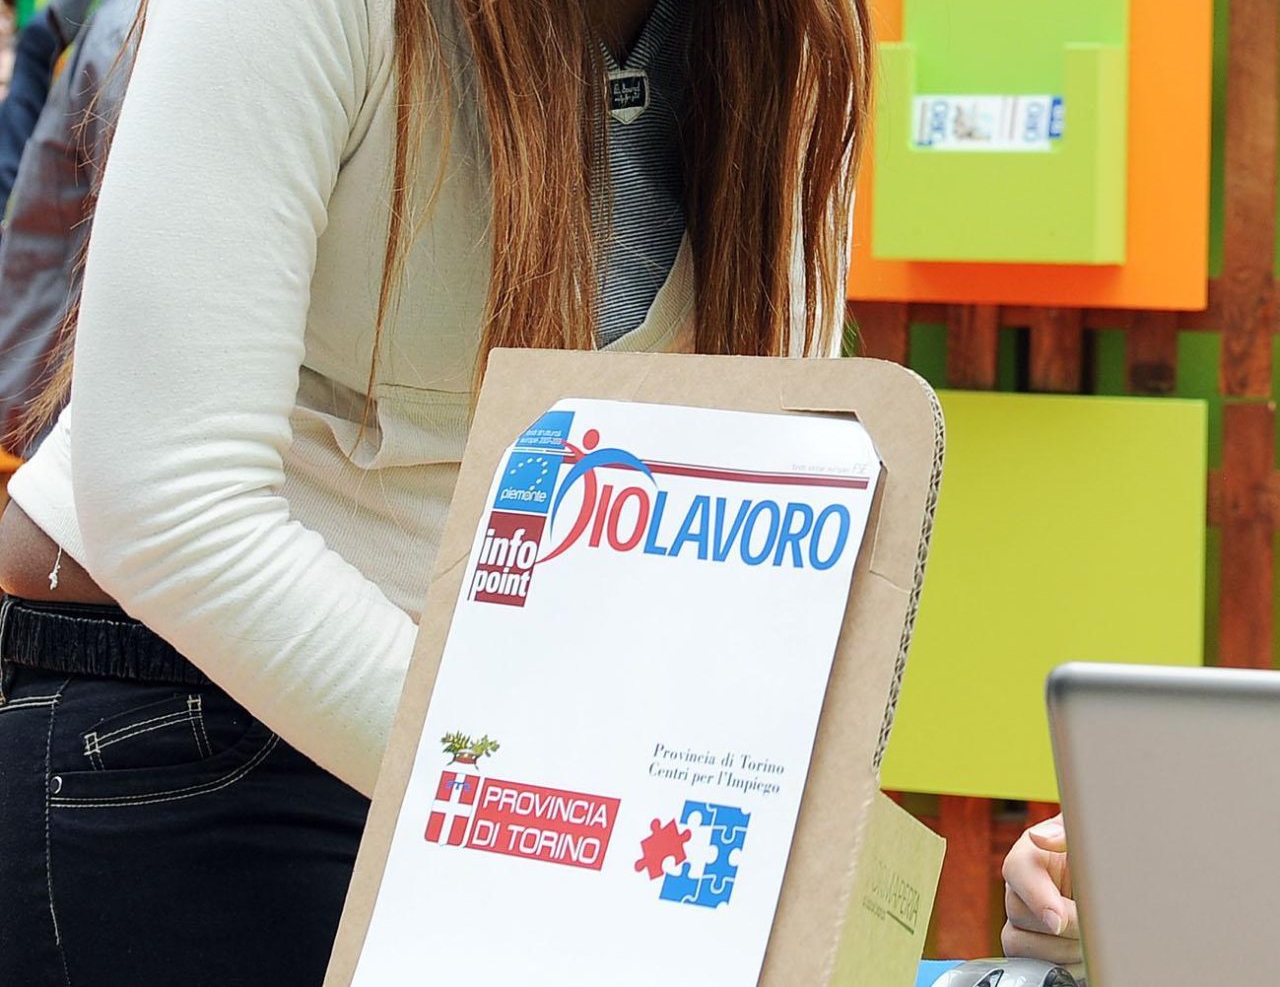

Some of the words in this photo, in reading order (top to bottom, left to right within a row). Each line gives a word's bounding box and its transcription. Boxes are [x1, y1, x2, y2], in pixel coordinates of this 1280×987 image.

[500, 487, 547, 503] piemonte
[588, 484, 851, 571] IOLAVORO
[479, 528, 538, 570] info
[468, 566, 531, 601] point
[653, 743, 716, 766] Provincia
[721, 752, 735, 768] di
[741, 754, 785, 774] Torino
[648, 761, 689, 781] Centri
[691, 773, 715, 786] per
[717, 771, 780, 795] l'Impiego
[483, 786, 608, 829] PROVINCIA
[471, 819, 501, 848] DI
[507, 824, 601, 864] TORINO
